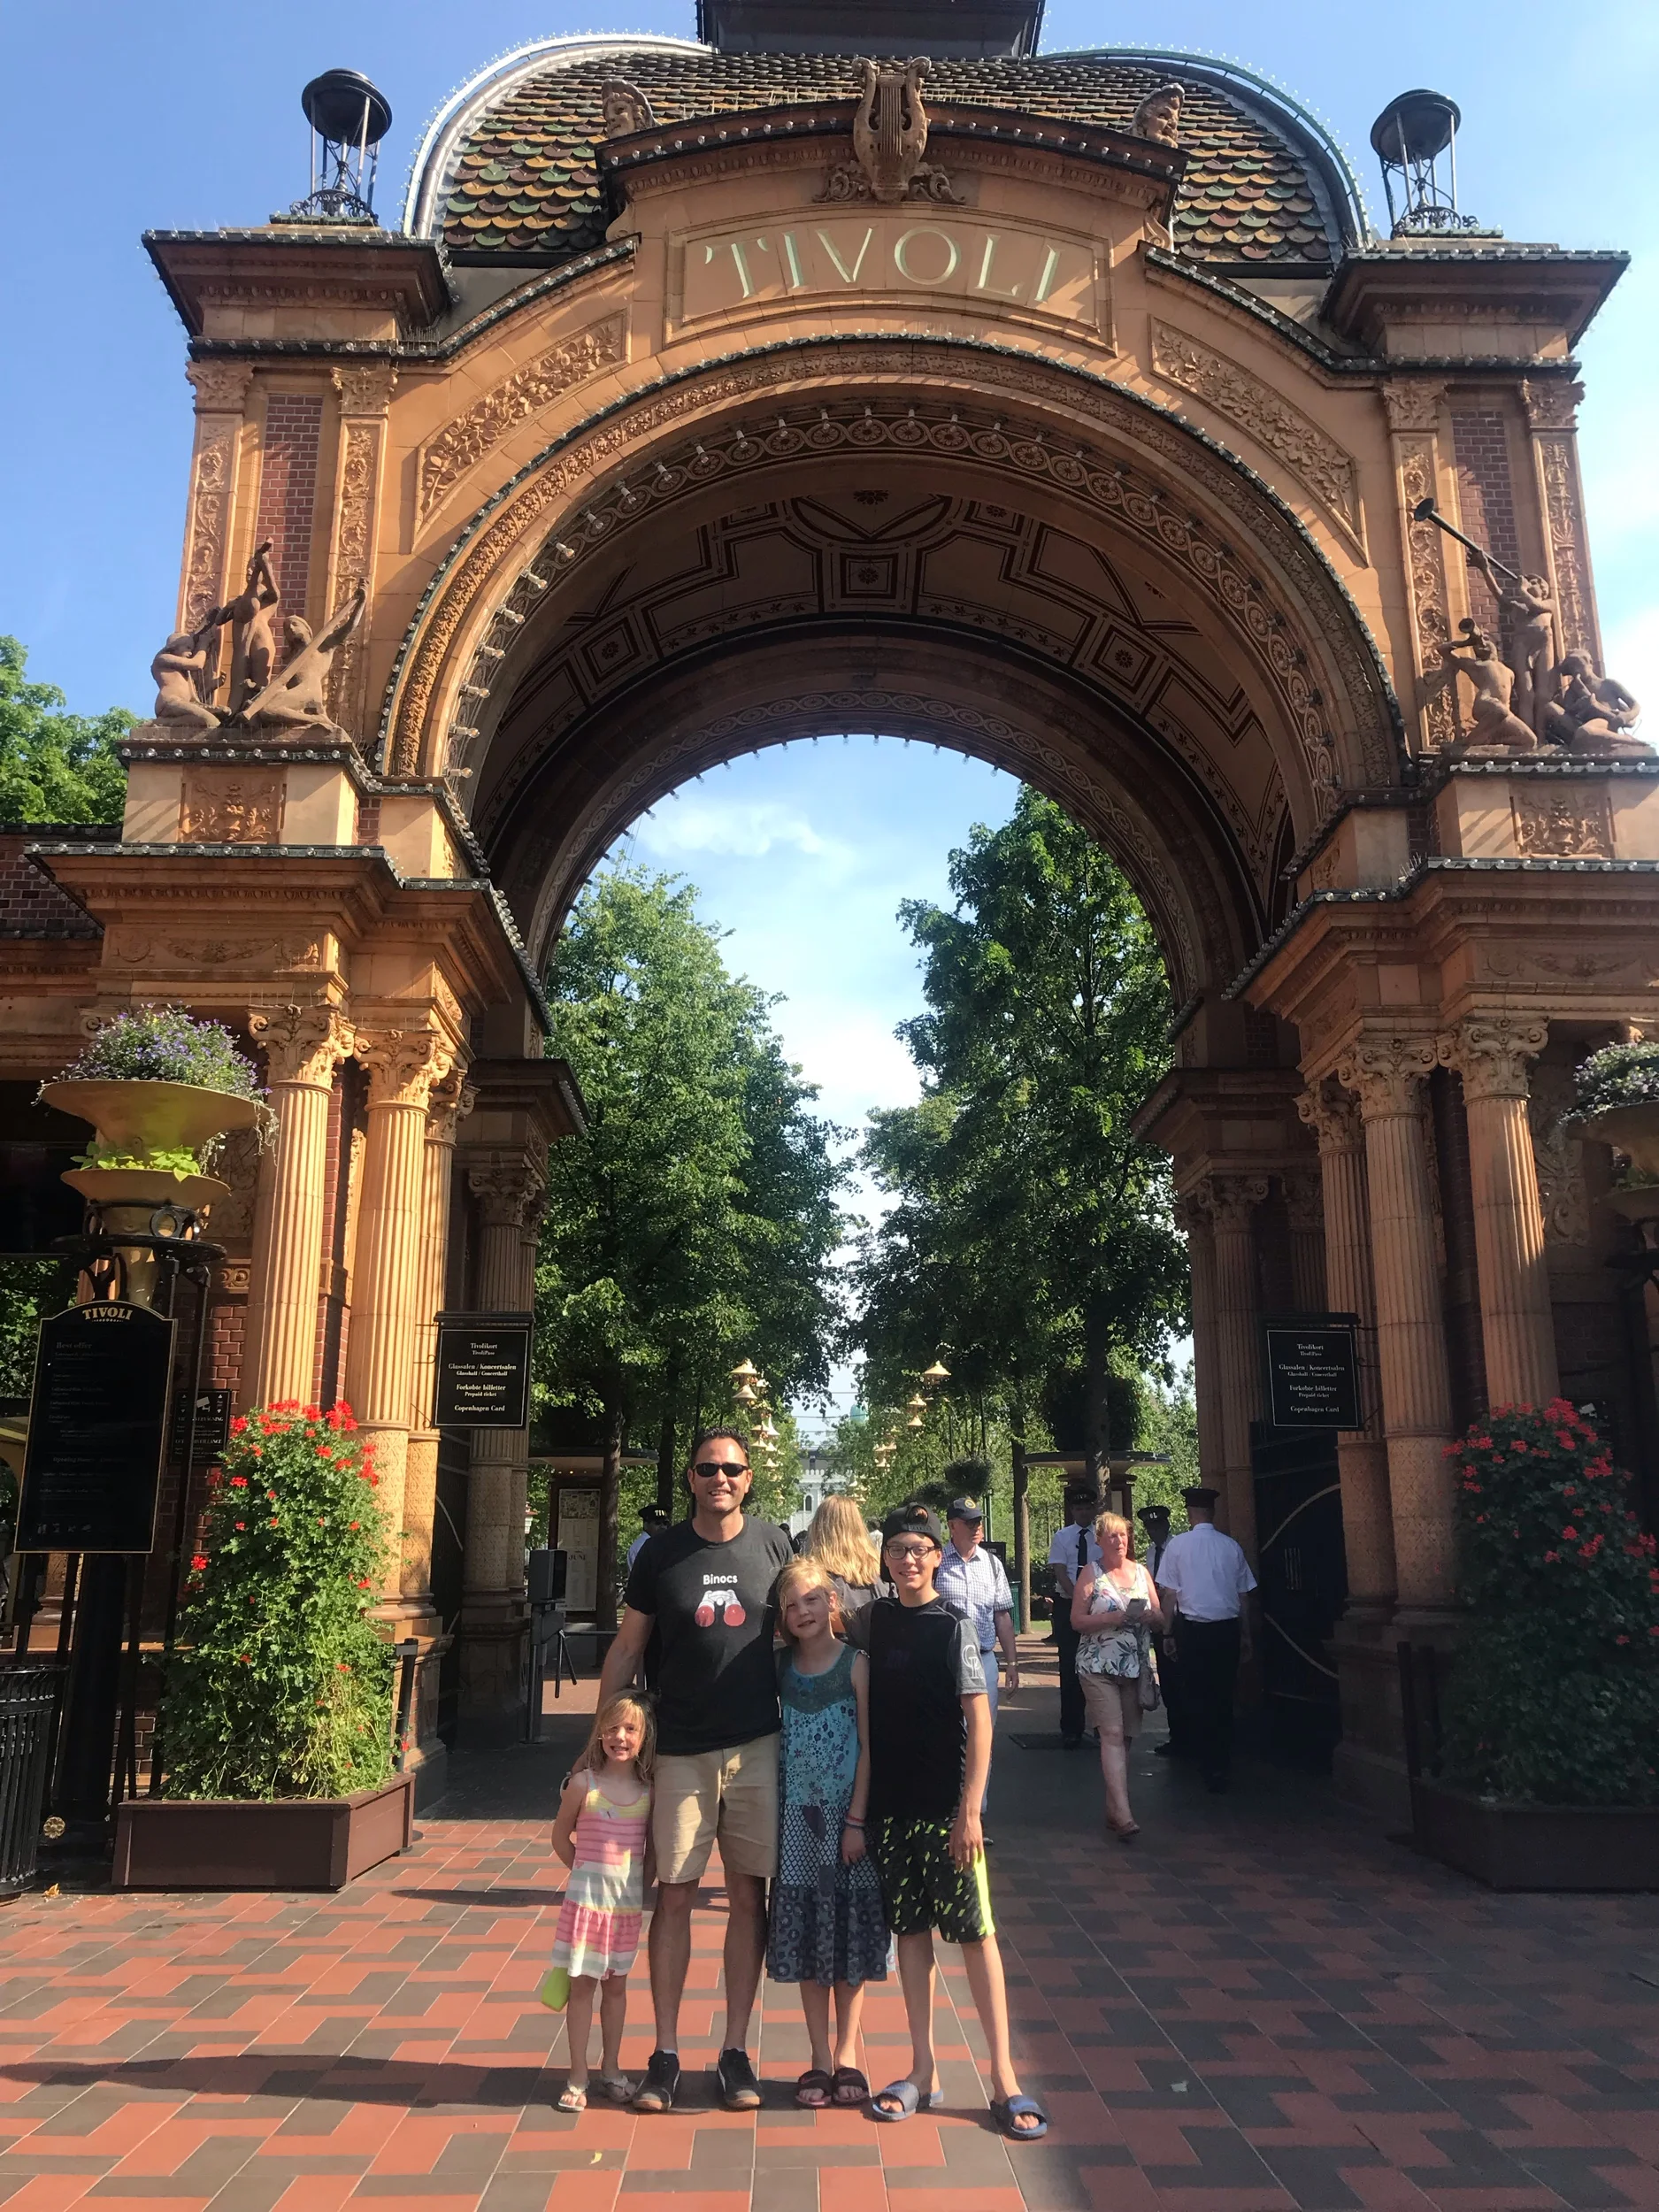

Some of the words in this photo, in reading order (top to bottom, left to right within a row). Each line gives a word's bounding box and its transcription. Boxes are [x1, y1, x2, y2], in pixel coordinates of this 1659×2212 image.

[703, 225, 1065, 303] TIVOLI
[82, 1307, 134, 1320] TIVOLI
[1290, 1405, 1325, 1414] Copenhagen
[703, 1573, 738, 1586] Binocs
